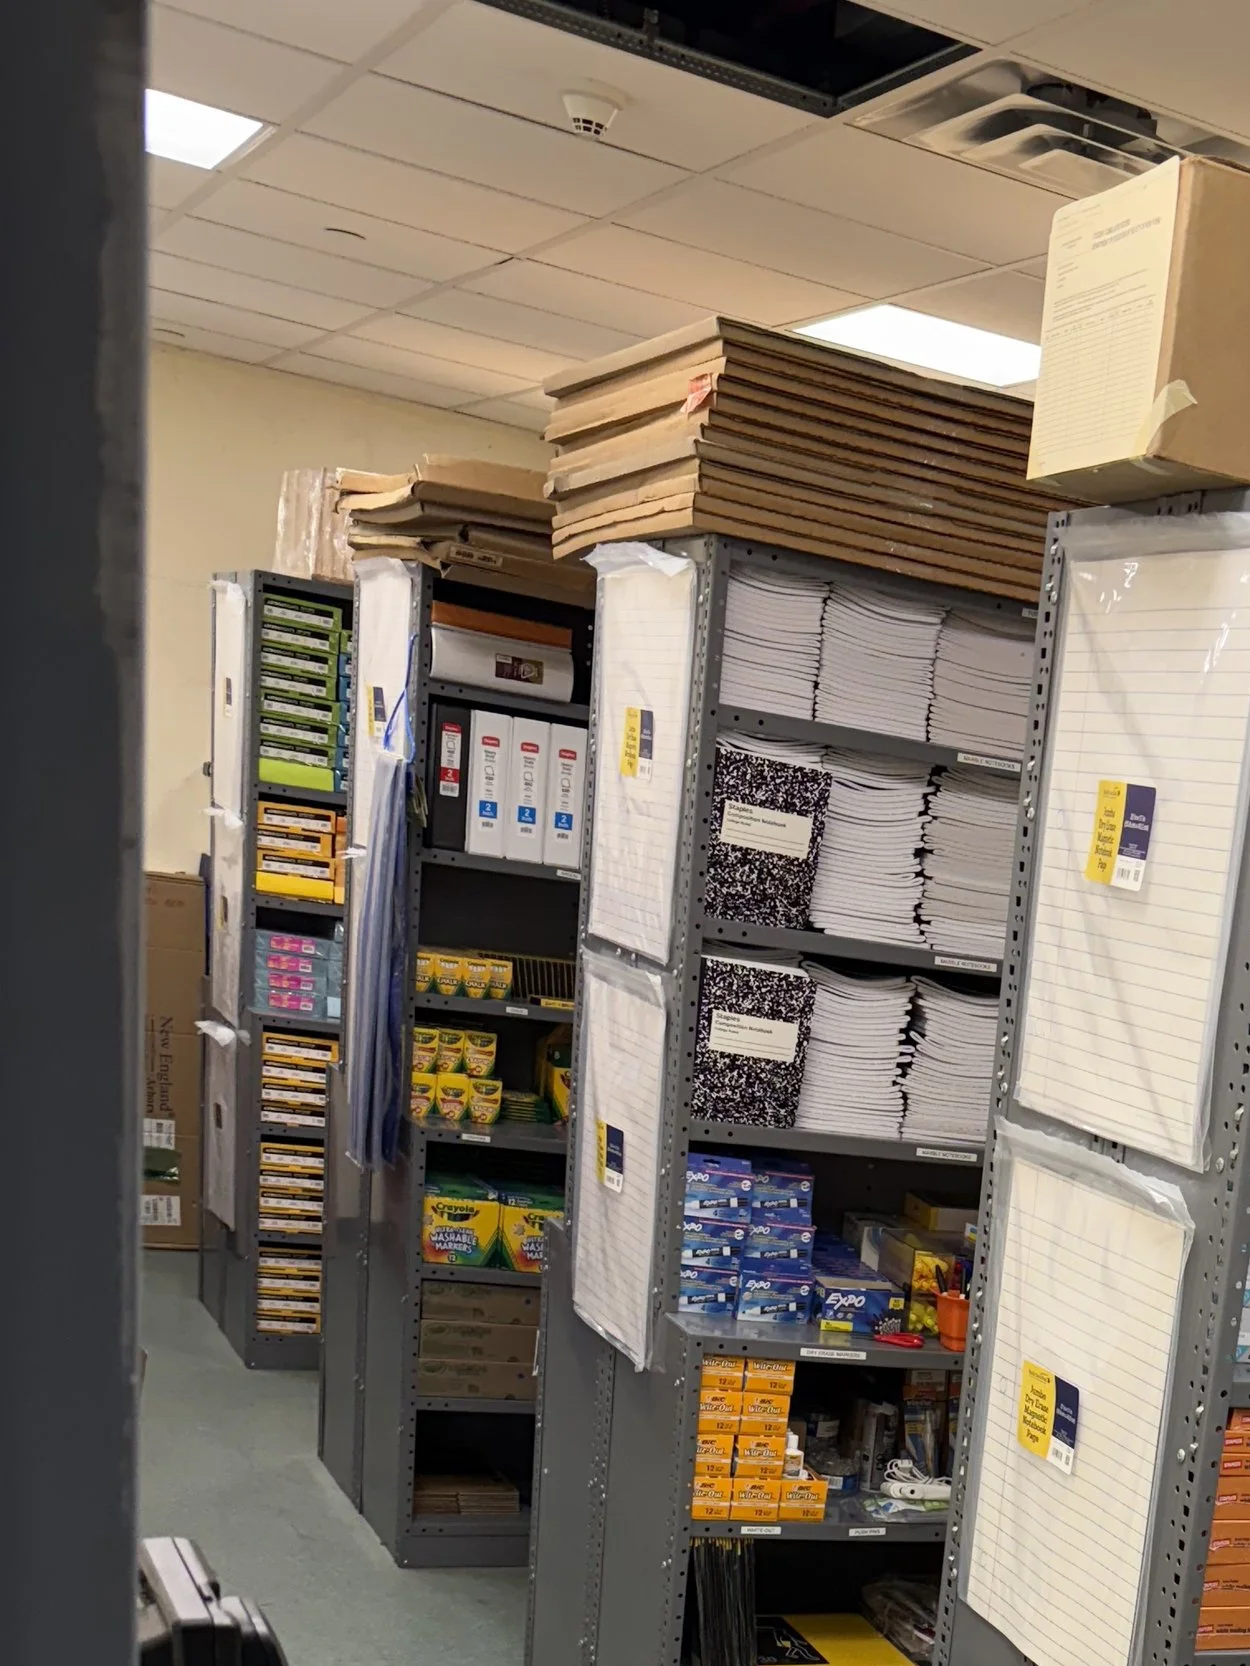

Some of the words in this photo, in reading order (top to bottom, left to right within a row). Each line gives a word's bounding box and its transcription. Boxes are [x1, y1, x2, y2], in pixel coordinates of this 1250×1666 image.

[728, 803, 753, 815] Staples
[727, 811, 760, 823] Composition
[761, 818, 786, 828] Notebook
[715, 1012, 740, 1023] Staples
[160, 1016, 174, 1036] New
[159, 1039, 175, 1116] England
[436, 1202, 475, 1214] Crayola
[430, 1232, 478, 1246] WASHABLE
[435, 1242, 472, 1254] MARKERS
[746, 1279, 771, 1291] EXPO
[826, 1293, 866, 1308] EXPO
